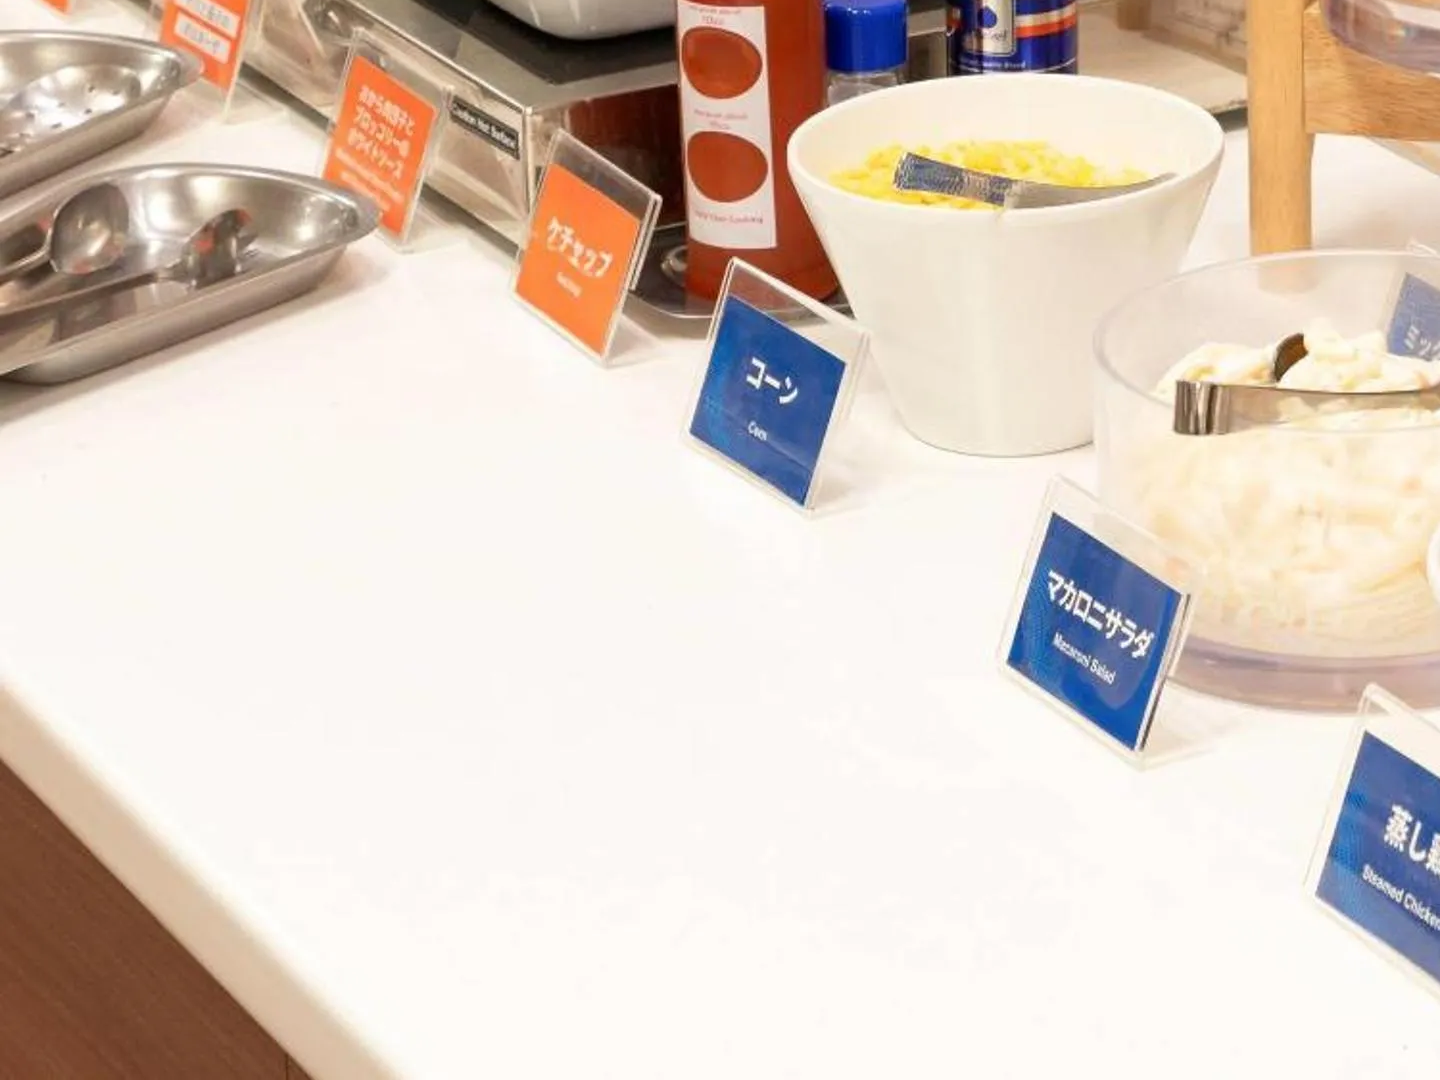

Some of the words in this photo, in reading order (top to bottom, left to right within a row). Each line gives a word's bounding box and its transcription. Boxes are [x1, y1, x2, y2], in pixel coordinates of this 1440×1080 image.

[545, 215, 614, 279] ケチャップ
[746, 356, 799, 405] コーン
[1047, 569, 1156, 659] マカロニサラダ
[1052, 631, 1092, 669] Macaroni
[1089, 658, 1117, 685] Salad
[1362, 863, 1405, 904] Steamed
